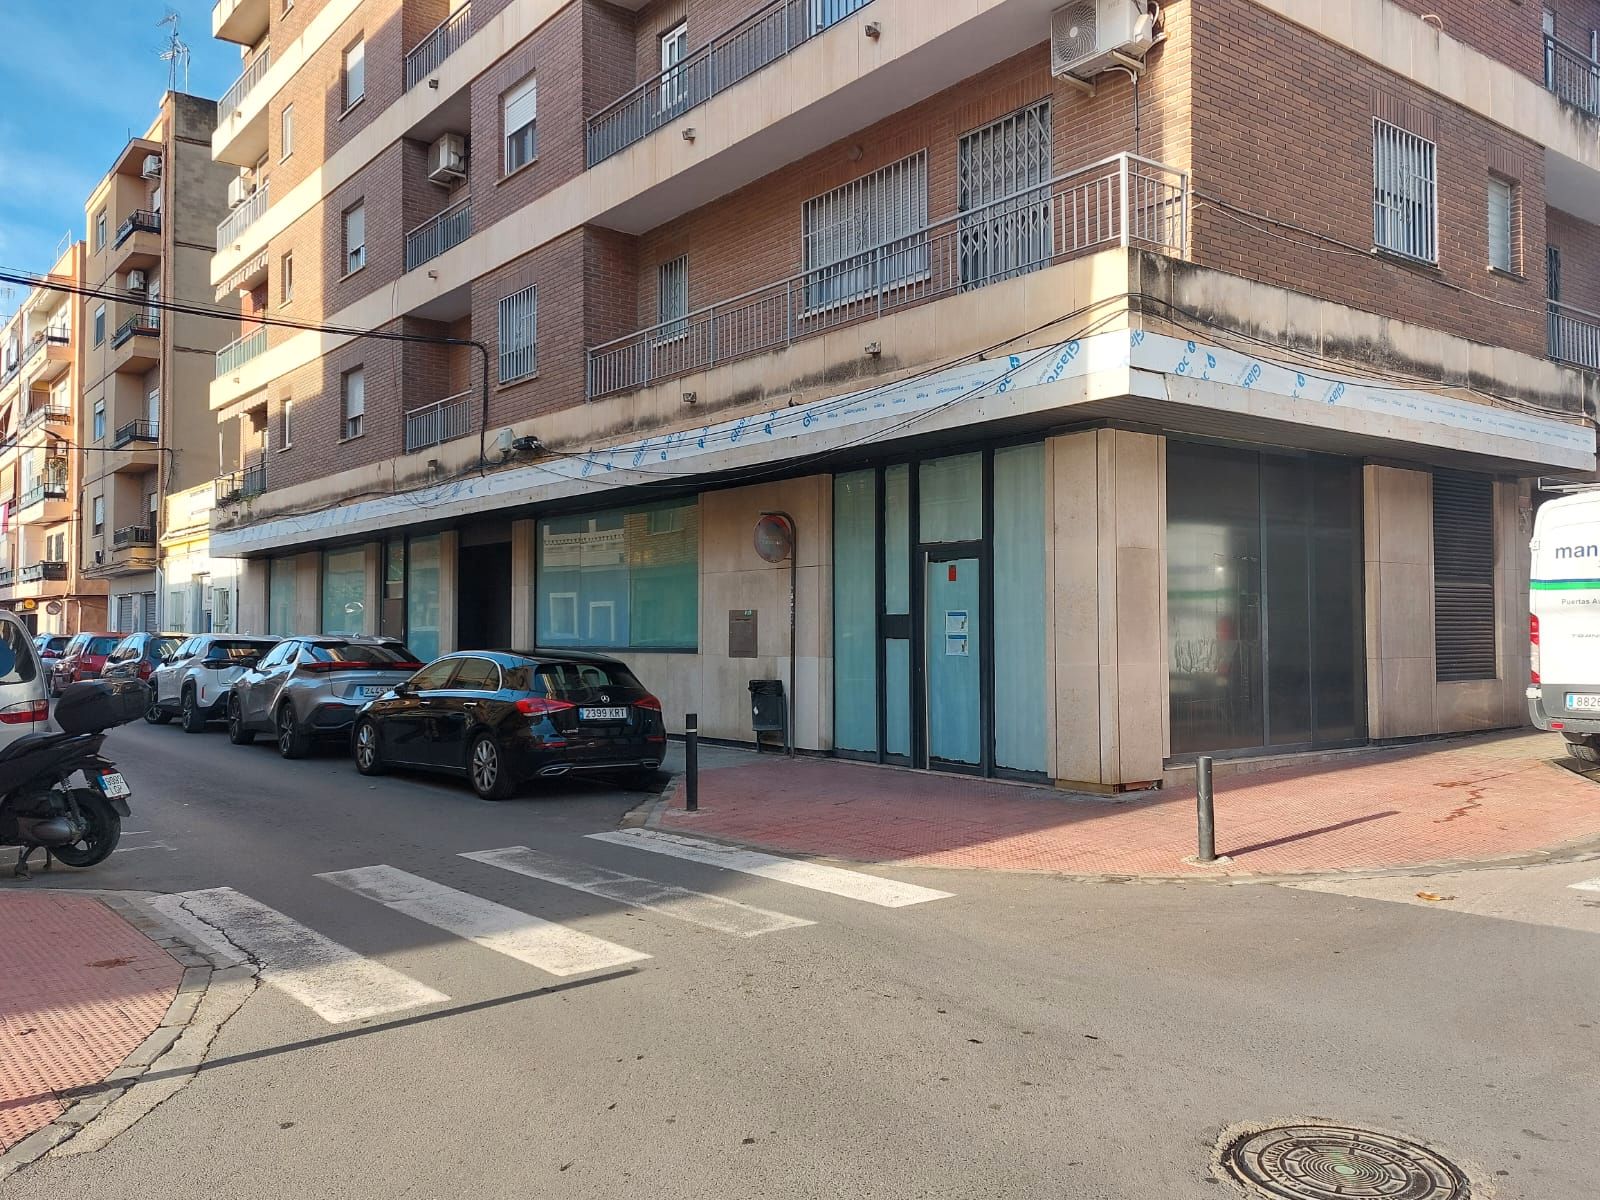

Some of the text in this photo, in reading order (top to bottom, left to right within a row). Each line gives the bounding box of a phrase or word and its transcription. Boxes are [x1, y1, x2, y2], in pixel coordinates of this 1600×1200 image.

[1555, 543, 1599, 560] man
[585, 708, 625, 718] 2399 KRT
